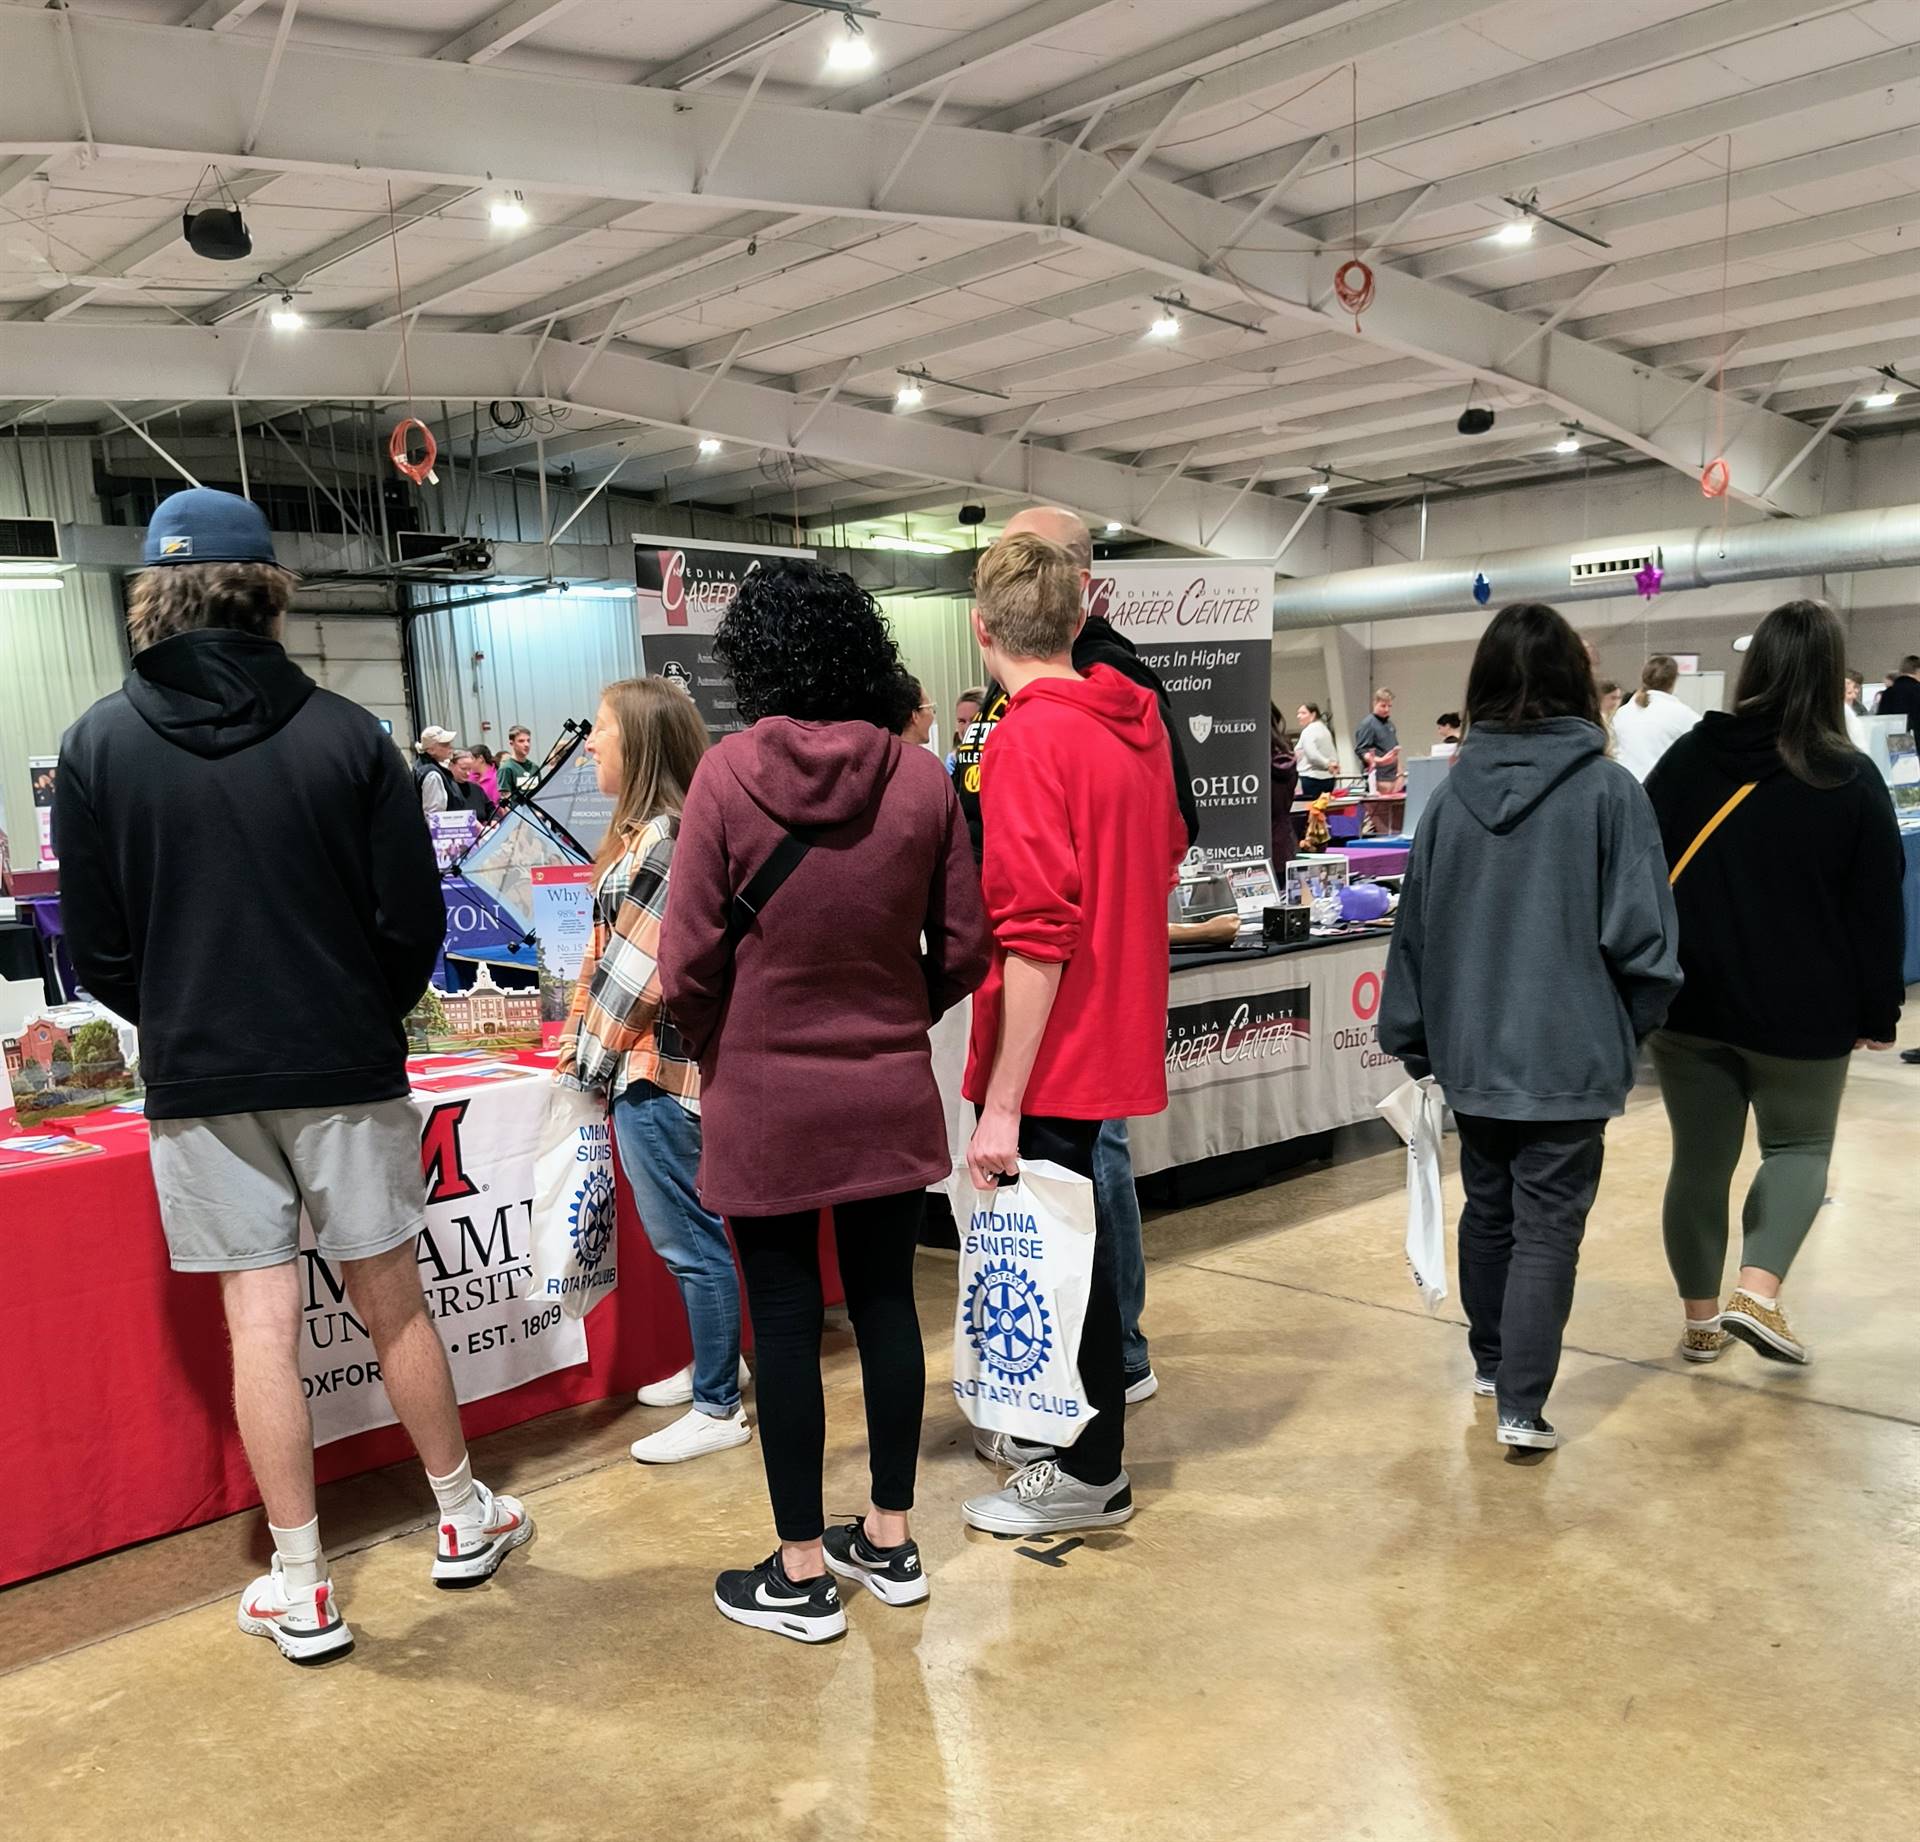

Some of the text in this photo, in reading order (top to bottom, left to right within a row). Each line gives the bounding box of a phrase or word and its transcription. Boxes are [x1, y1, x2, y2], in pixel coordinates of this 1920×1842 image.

[1088, 577, 1260, 627] CAREER CENTER
[1136, 648, 1241, 670] tners In Higher
[1161, 675, 1212, 692] cation
[1213, 722, 1257, 735] TOLEDO
[1191, 774, 1260, 797] OHIO
[1206, 844, 1265, 860] SINCLAIR
[546, 888, 580, 905] Why
[1165, 1003, 1293, 1072] AREER CENTER
[1167, 1021, 1220, 1039] EDINA
[1333, 1027, 1368, 1051] Ohio
[970, 1211, 1038, 1234] MDINA
[965, 1235, 1044, 1260] SUNRISE
[547, 1270, 592, 1295] ROTARY
[467, 1324, 516, 1354] EST.
[520, 1305, 562, 1340] 1809
[952, 1379, 1080, 1418] ROTARY CLUB
